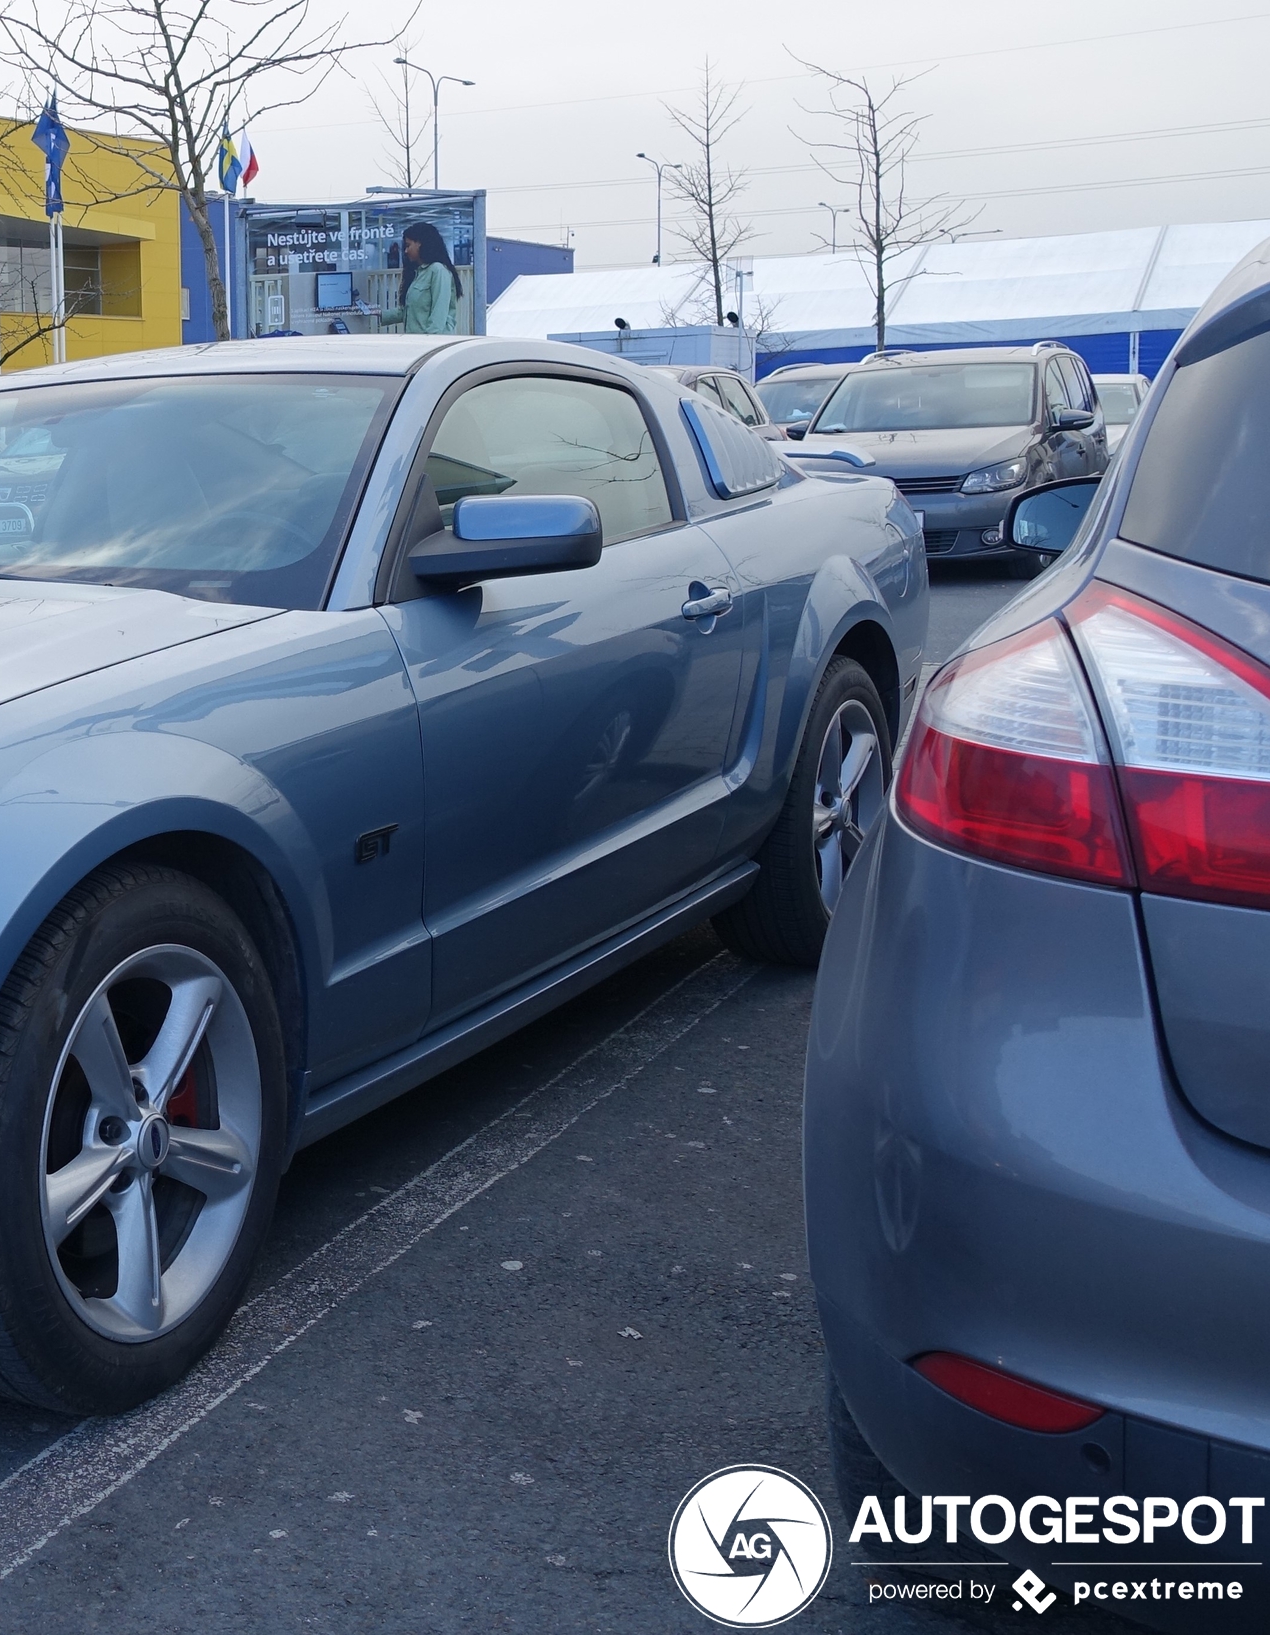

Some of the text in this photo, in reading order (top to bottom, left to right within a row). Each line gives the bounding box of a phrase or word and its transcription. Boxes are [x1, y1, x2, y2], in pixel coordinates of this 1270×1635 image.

[267, 223, 395, 247] Nestůjte ve frontě
[267, 246, 368, 266] a ušetřete čas.
[2, 520, 22, 531] 3709
[355, 822, 399, 865] GT
